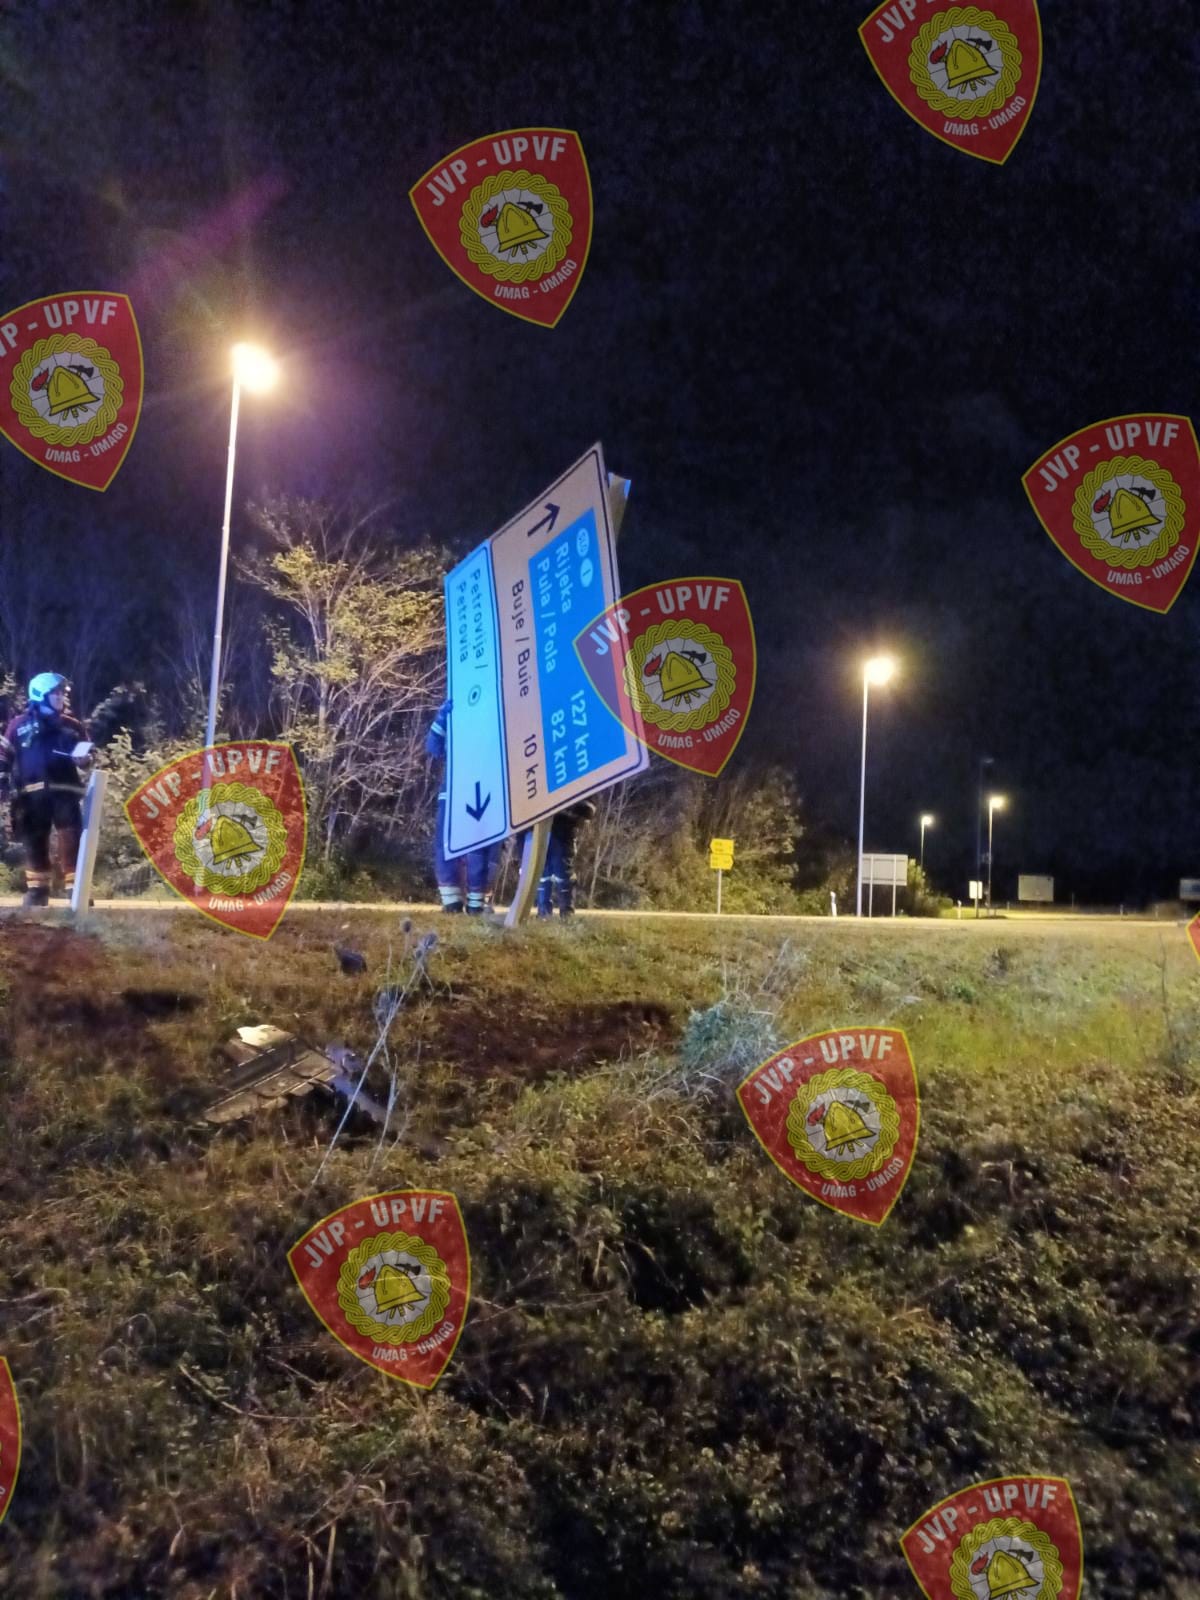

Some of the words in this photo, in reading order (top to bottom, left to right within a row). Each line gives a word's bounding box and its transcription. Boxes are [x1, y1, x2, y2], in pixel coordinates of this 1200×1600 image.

[537, 557, 552, 607] Pula
[555, 542, 574, 614] Rijeka
[456, 582, 470, 662] Petrovia
[470, 568, 486, 659] Petrovija
[512, 580, 526, 630] Buje
[544, 622, 558, 673] Pola
[518, 648, 532, 697] Buie
[552, 709, 566, 742] 82
[570, 690, 587, 726] 127
[523, 734, 538, 758] 10
[554, 746, 568, 784] km
[574, 733, 590, 772] km
[526, 764, 538, 800] km
